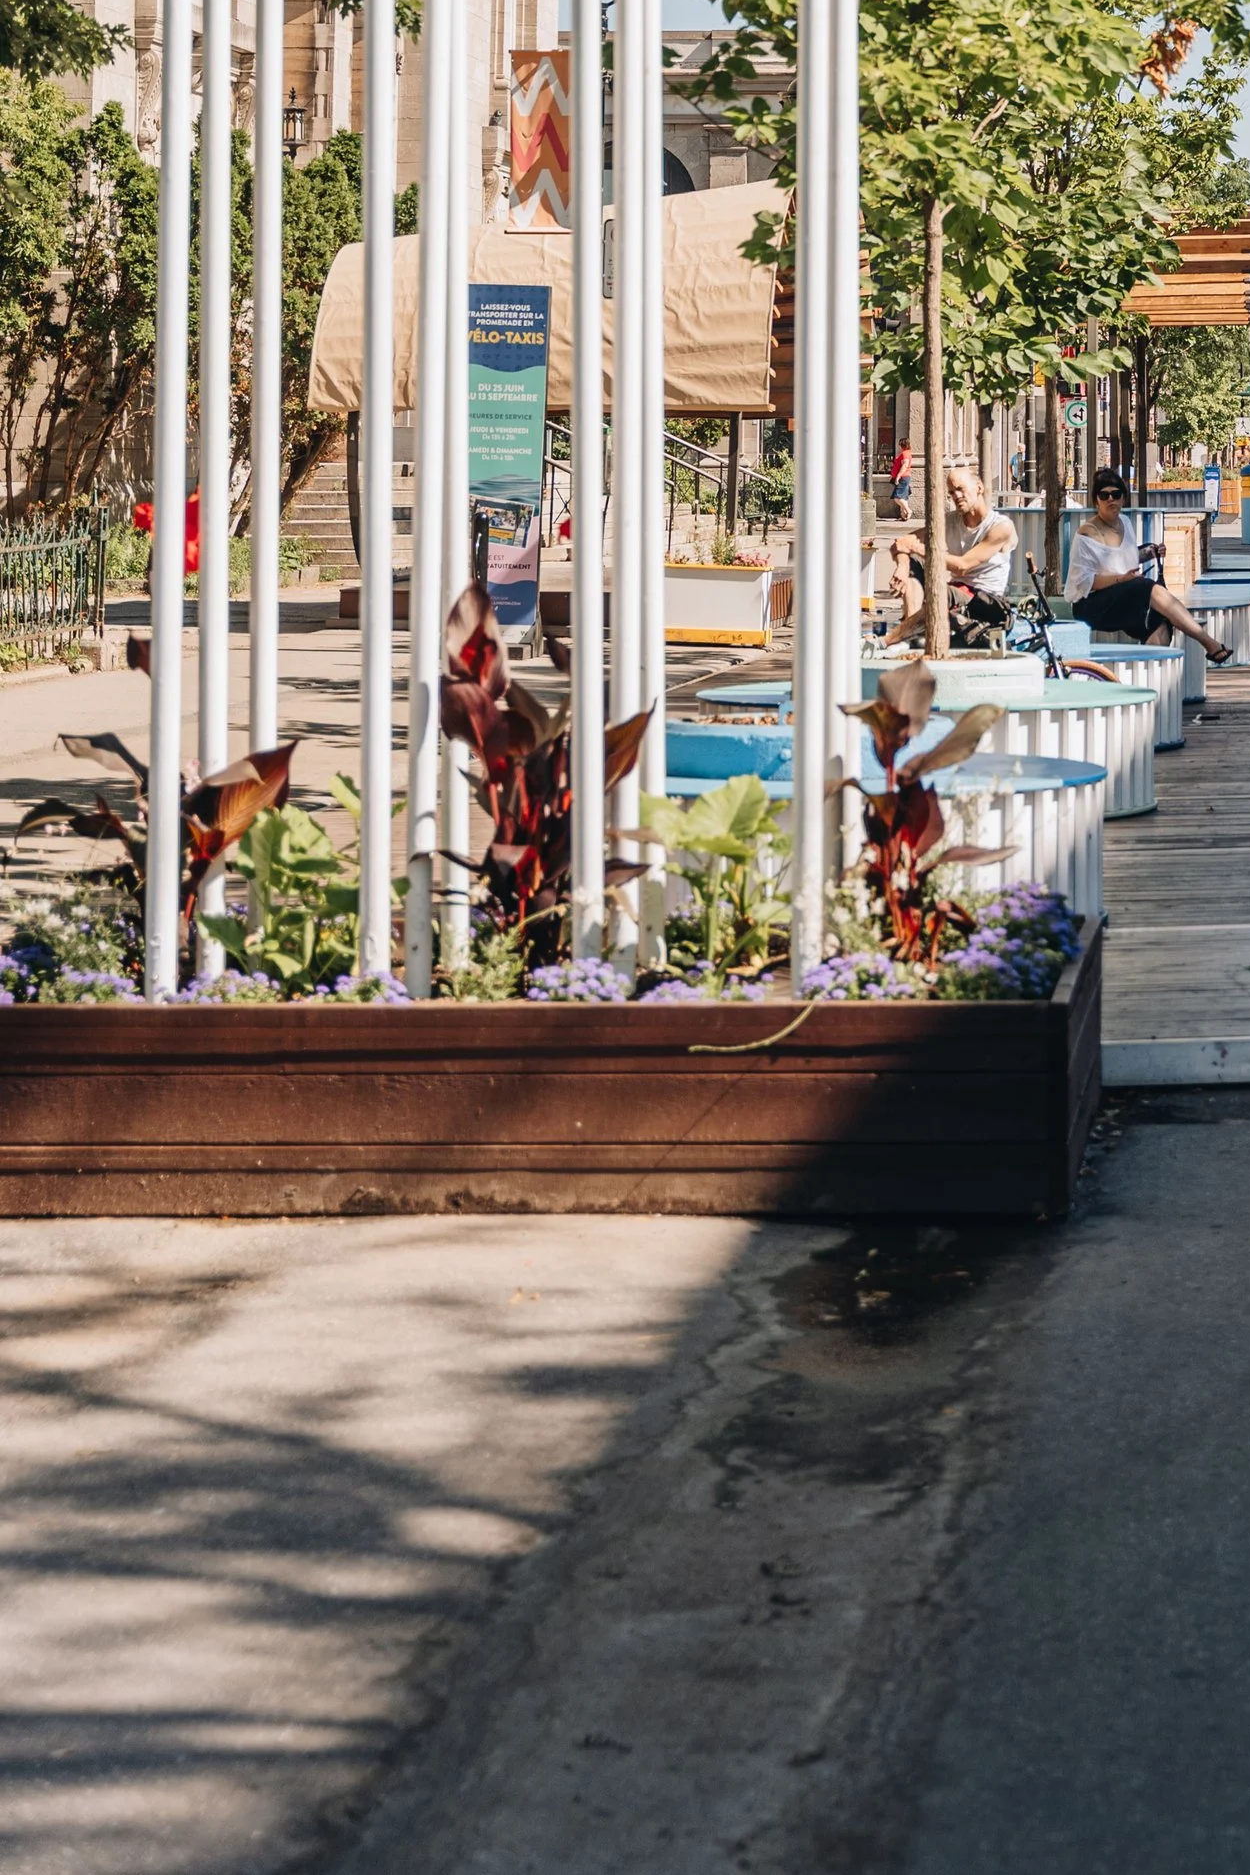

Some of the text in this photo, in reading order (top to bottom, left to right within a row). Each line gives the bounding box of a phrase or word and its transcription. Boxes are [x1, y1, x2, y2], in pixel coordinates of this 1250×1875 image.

[480, 303, 531, 311] LAISSEZ-VOUS
[476, 318, 522, 326] PROMENADE
[478, 383, 491, 391] DU
[503, 384, 525, 392] JUIN
[487, 393, 538, 402] SEPTEMBRE
